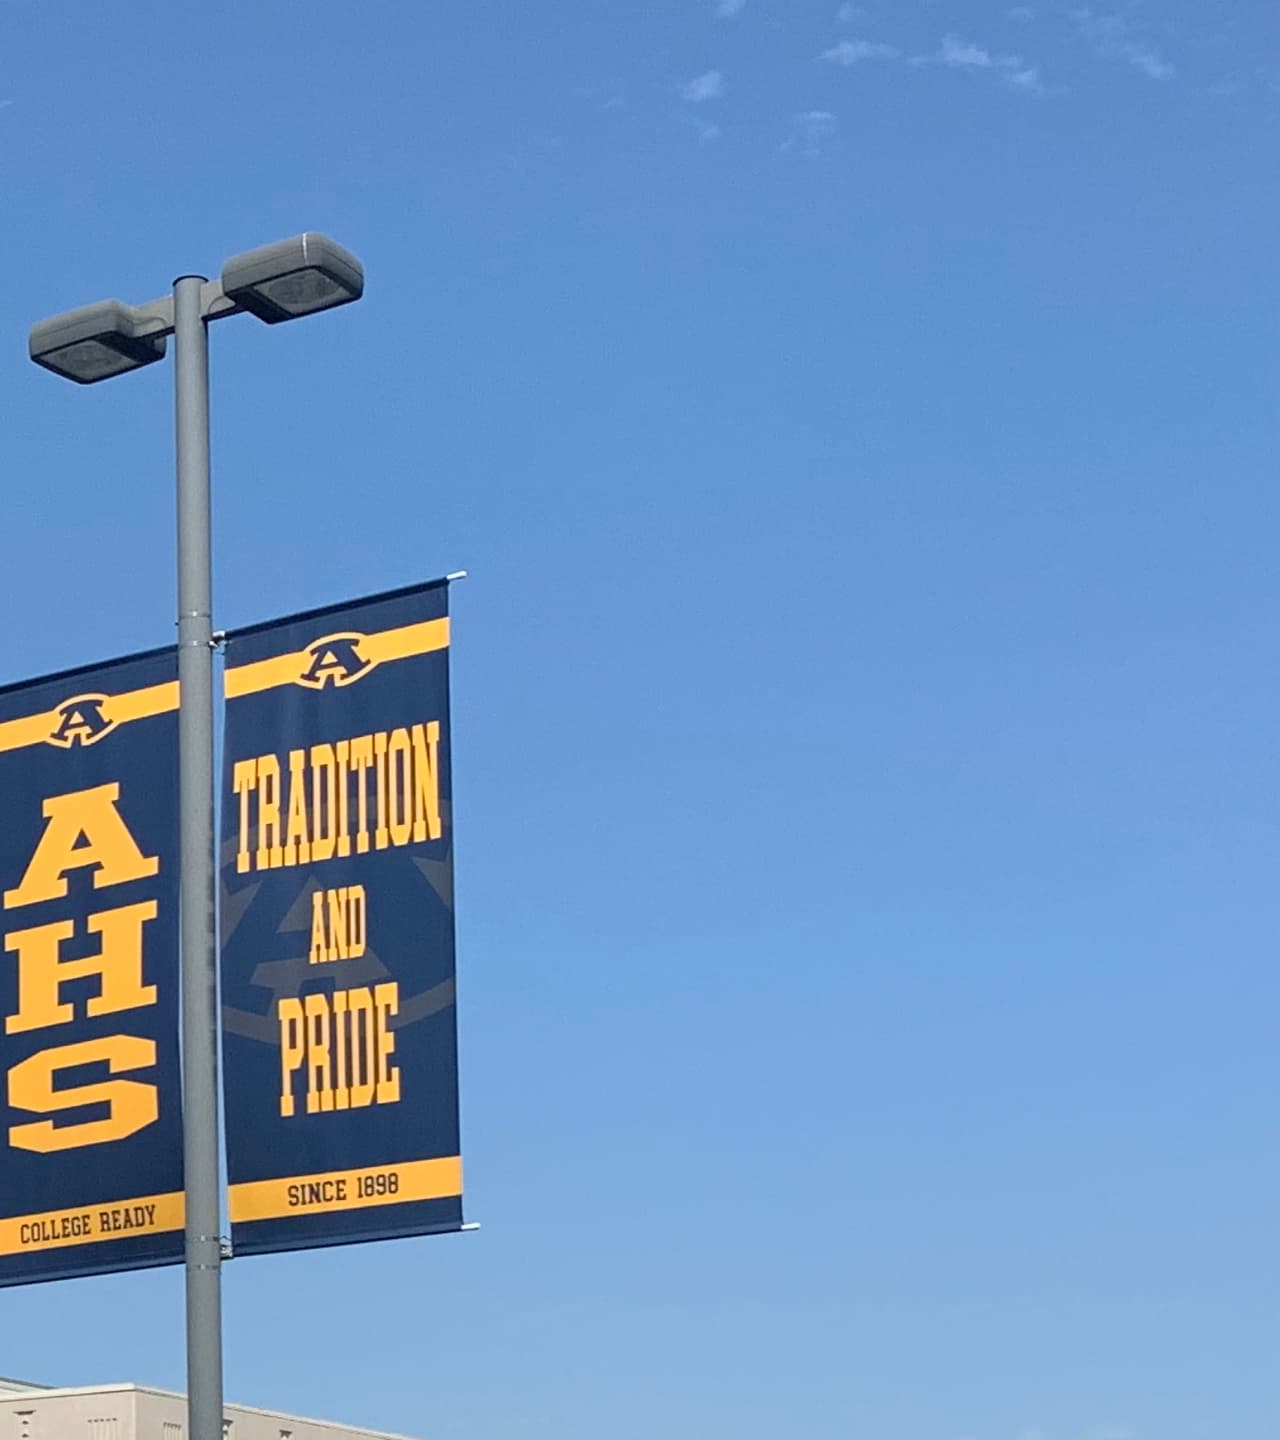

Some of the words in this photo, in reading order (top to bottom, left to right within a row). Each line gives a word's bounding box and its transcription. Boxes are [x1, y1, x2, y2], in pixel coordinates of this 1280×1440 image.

[233, 721, 442, 873] TRADITION
[3, 782, 159, 1153] AHS
[309, 885, 367, 964] AND
[278, 982, 401, 1117] PRIDE
[20, 1214, 91, 1244] COLLEGE
[99, 1204, 157, 1233] READY
[288, 1179, 347, 1207] SINCE
[357, 1172, 400, 1199] 1898
